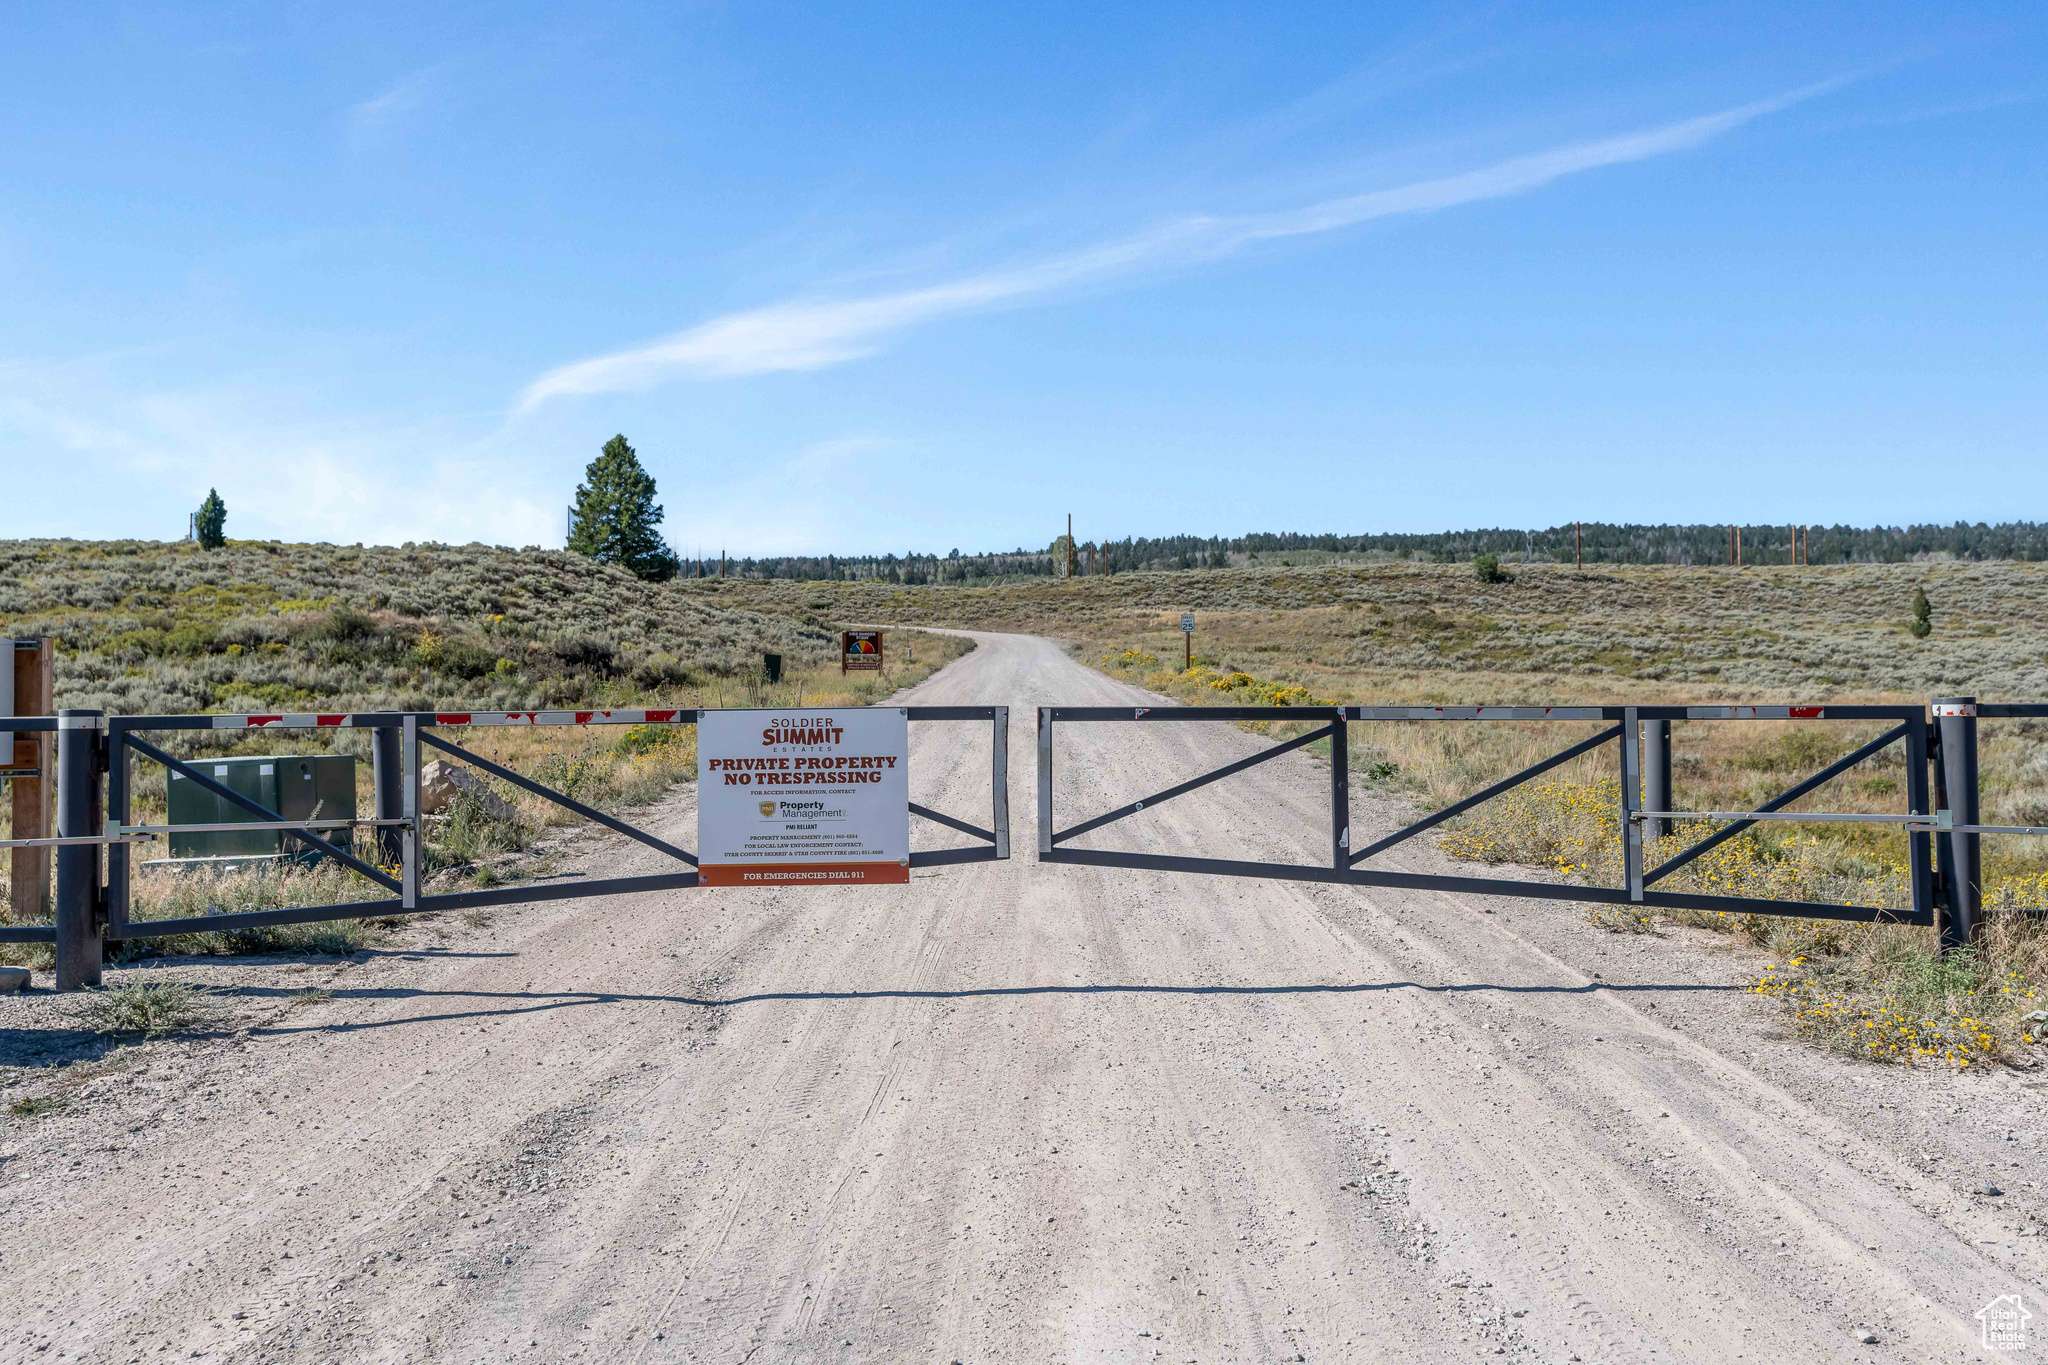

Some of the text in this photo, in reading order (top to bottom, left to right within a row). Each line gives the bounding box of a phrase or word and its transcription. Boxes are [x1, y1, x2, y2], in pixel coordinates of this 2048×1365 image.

[1182, 623, 1194, 631] 25
[771, 717, 833, 728] SOLDIER
[761, 727, 844, 747] SUMMIT
[708, 756, 897, 771] PRIVATE PROPERTY
[724, 771, 882, 785] NO TRESPASSING
[780, 800, 824, 812] Property
[782, 808, 843, 820] Management
[743, 871, 865, 881] FOR EMERGENCIES DIAL 911
